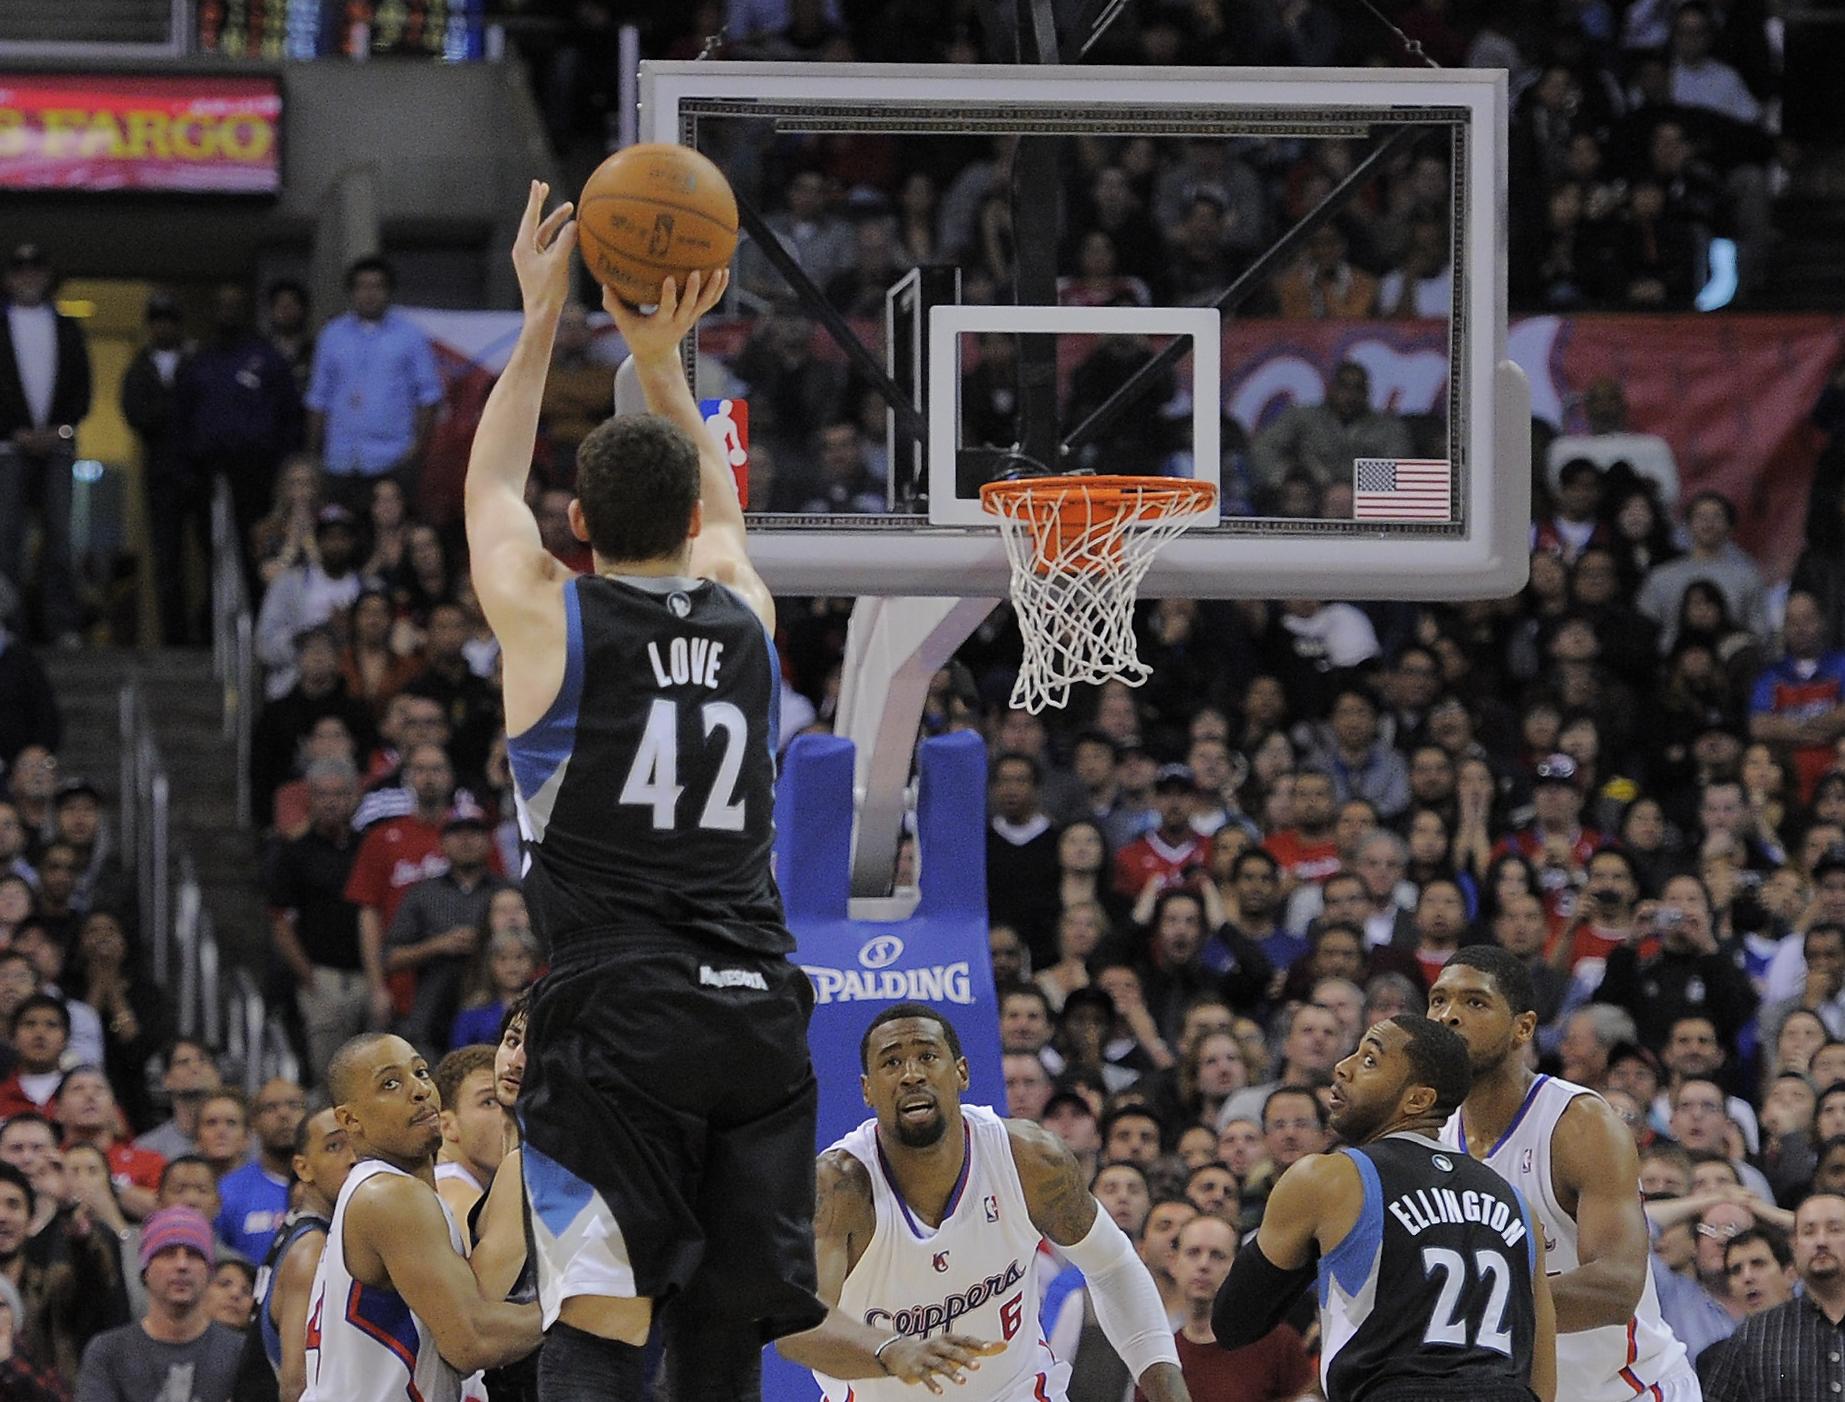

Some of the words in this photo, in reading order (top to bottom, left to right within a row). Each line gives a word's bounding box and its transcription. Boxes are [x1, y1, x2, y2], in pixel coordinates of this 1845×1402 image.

[42, 110, 271, 160] FARGO
[647, 636, 724, 690] LOVE
[619, 698, 748, 831] 42
[800, 961, 972, 1005] PALDING
[1387, 1187, 1527, 1248] ELLINGTON
[864, 1259, 1026, 1339] Clippers
[998, 1290, 1023, 1342] 6
[1422, 1247, 1513, 1359] 22
